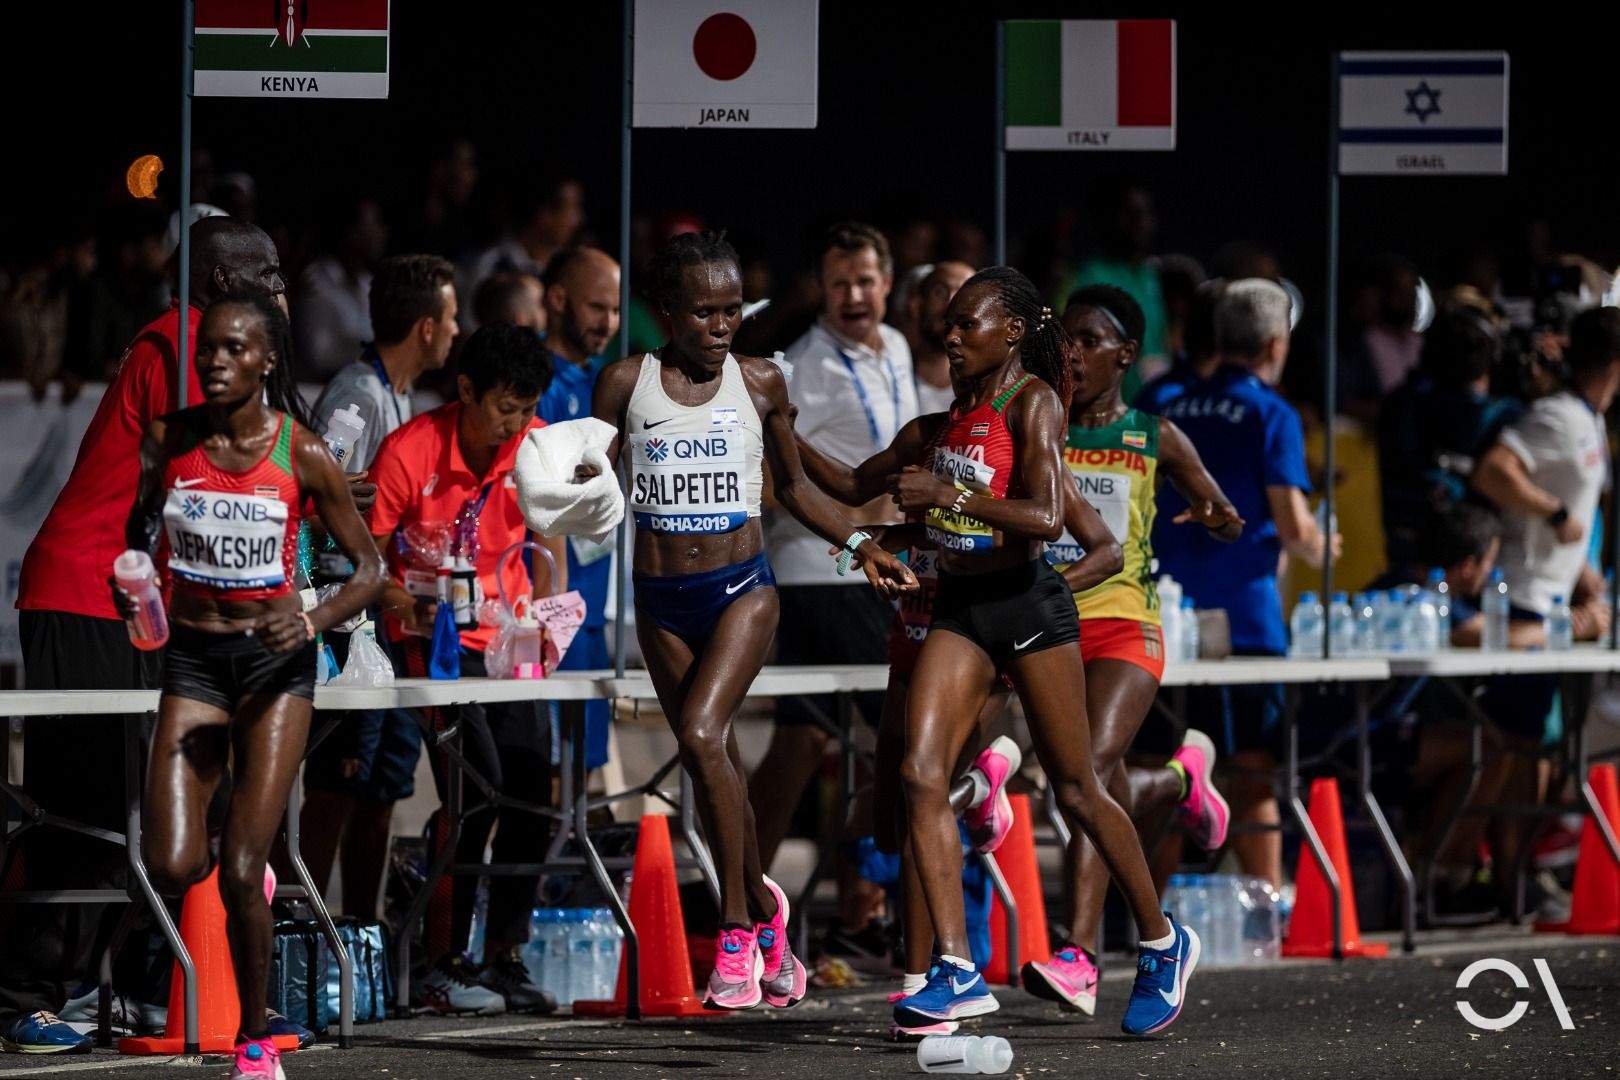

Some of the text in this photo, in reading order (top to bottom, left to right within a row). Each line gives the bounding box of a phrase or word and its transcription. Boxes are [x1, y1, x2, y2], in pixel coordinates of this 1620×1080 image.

[261, 76, 319, 92] KENYA
[698, 108, 750, 125] JAPAN
[1067, 130, 1111, 146] ITALY
[1395, 154, 1446, 169] ISRAEL
[673, 438, 728, 459] QNB
[945, 458, 976, 483] QNB
[634, 471, 740, 505] SALPETER
[213, 499, 268, 522] QNB
[651, 516, 730, 532] DOHA2019
[174, 530, 276, 569] JEPKESHO
[926, 527, 975, 551] DOHA2019
